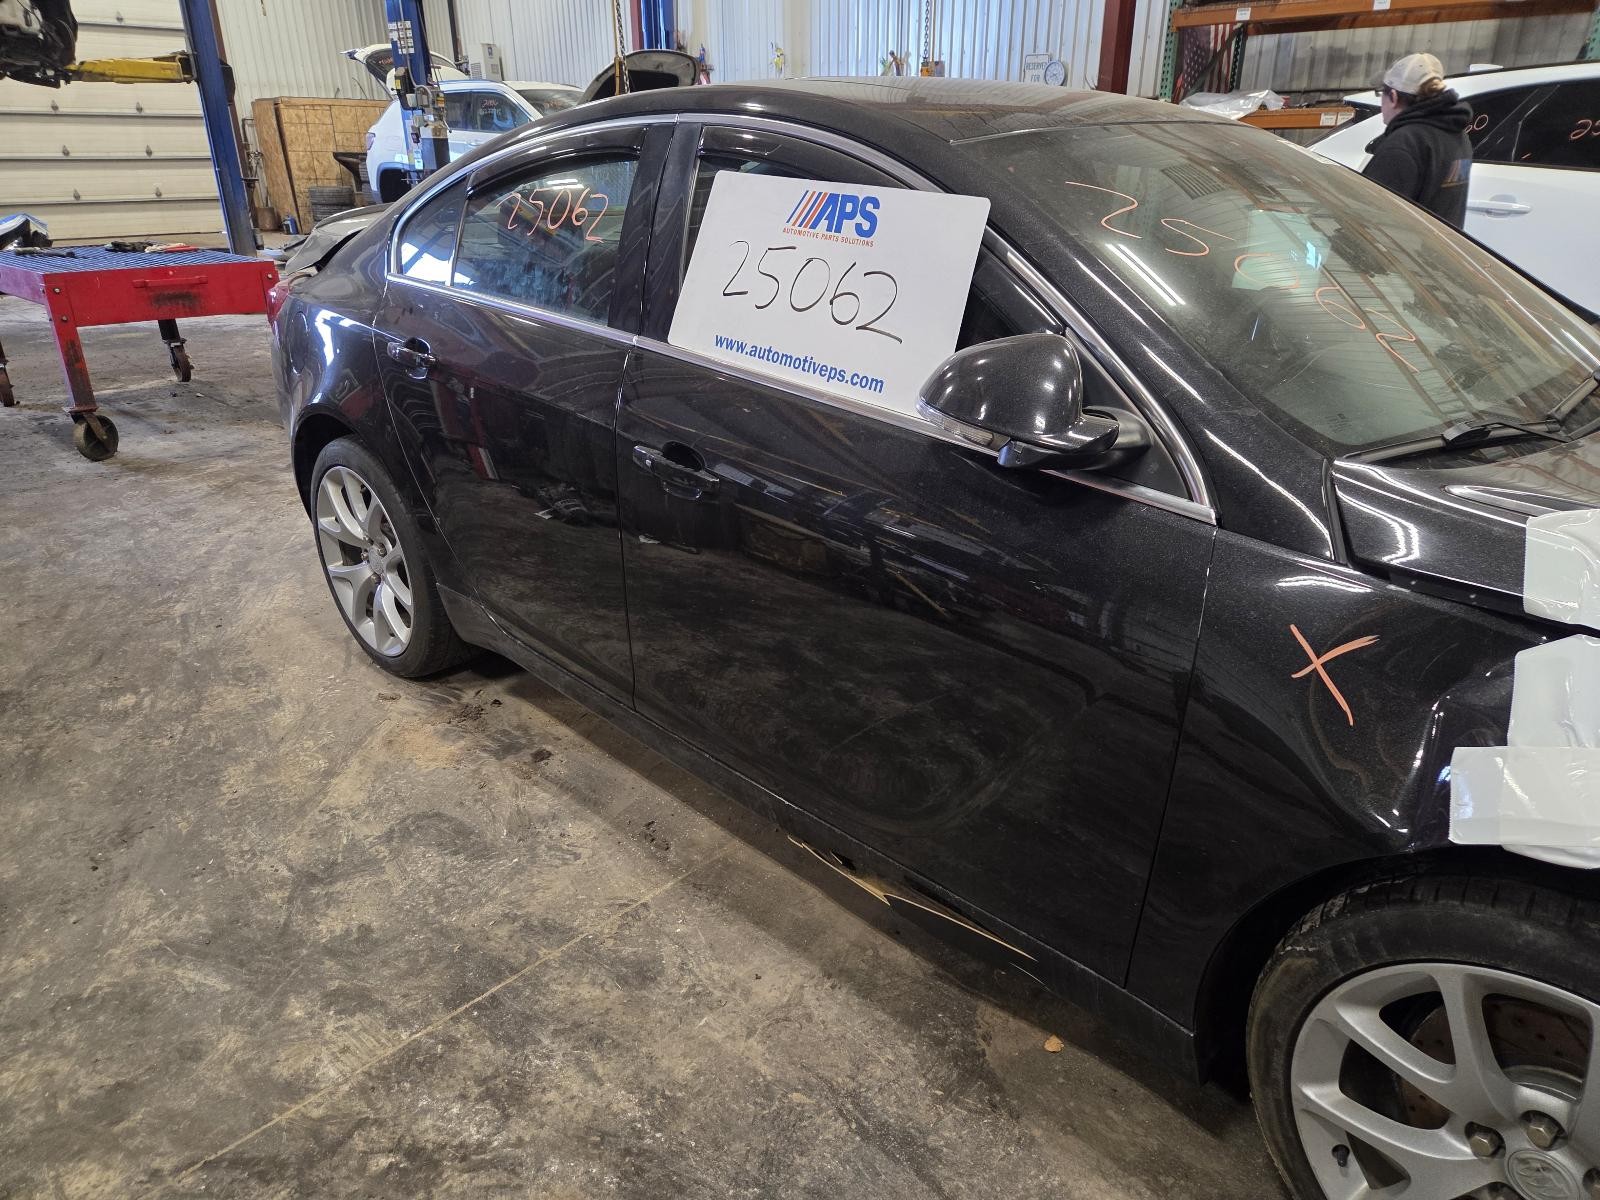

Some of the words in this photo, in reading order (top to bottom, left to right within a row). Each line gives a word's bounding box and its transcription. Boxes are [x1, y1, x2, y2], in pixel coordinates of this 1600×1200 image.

[1031, 74, 1040, 82] FOR
[494, 187, 609, 243] 25062
[782, 226, 819, 239] AUTOMOTIVE
[820, 233, 840, 243] PARTS
[840, 236, 874, 248] SOLUTIONS
[808, 192, 880, 238] APS
[722, 240, 903, 344] 25062
[714, 334, 885, 394] www.automotiveps.com
